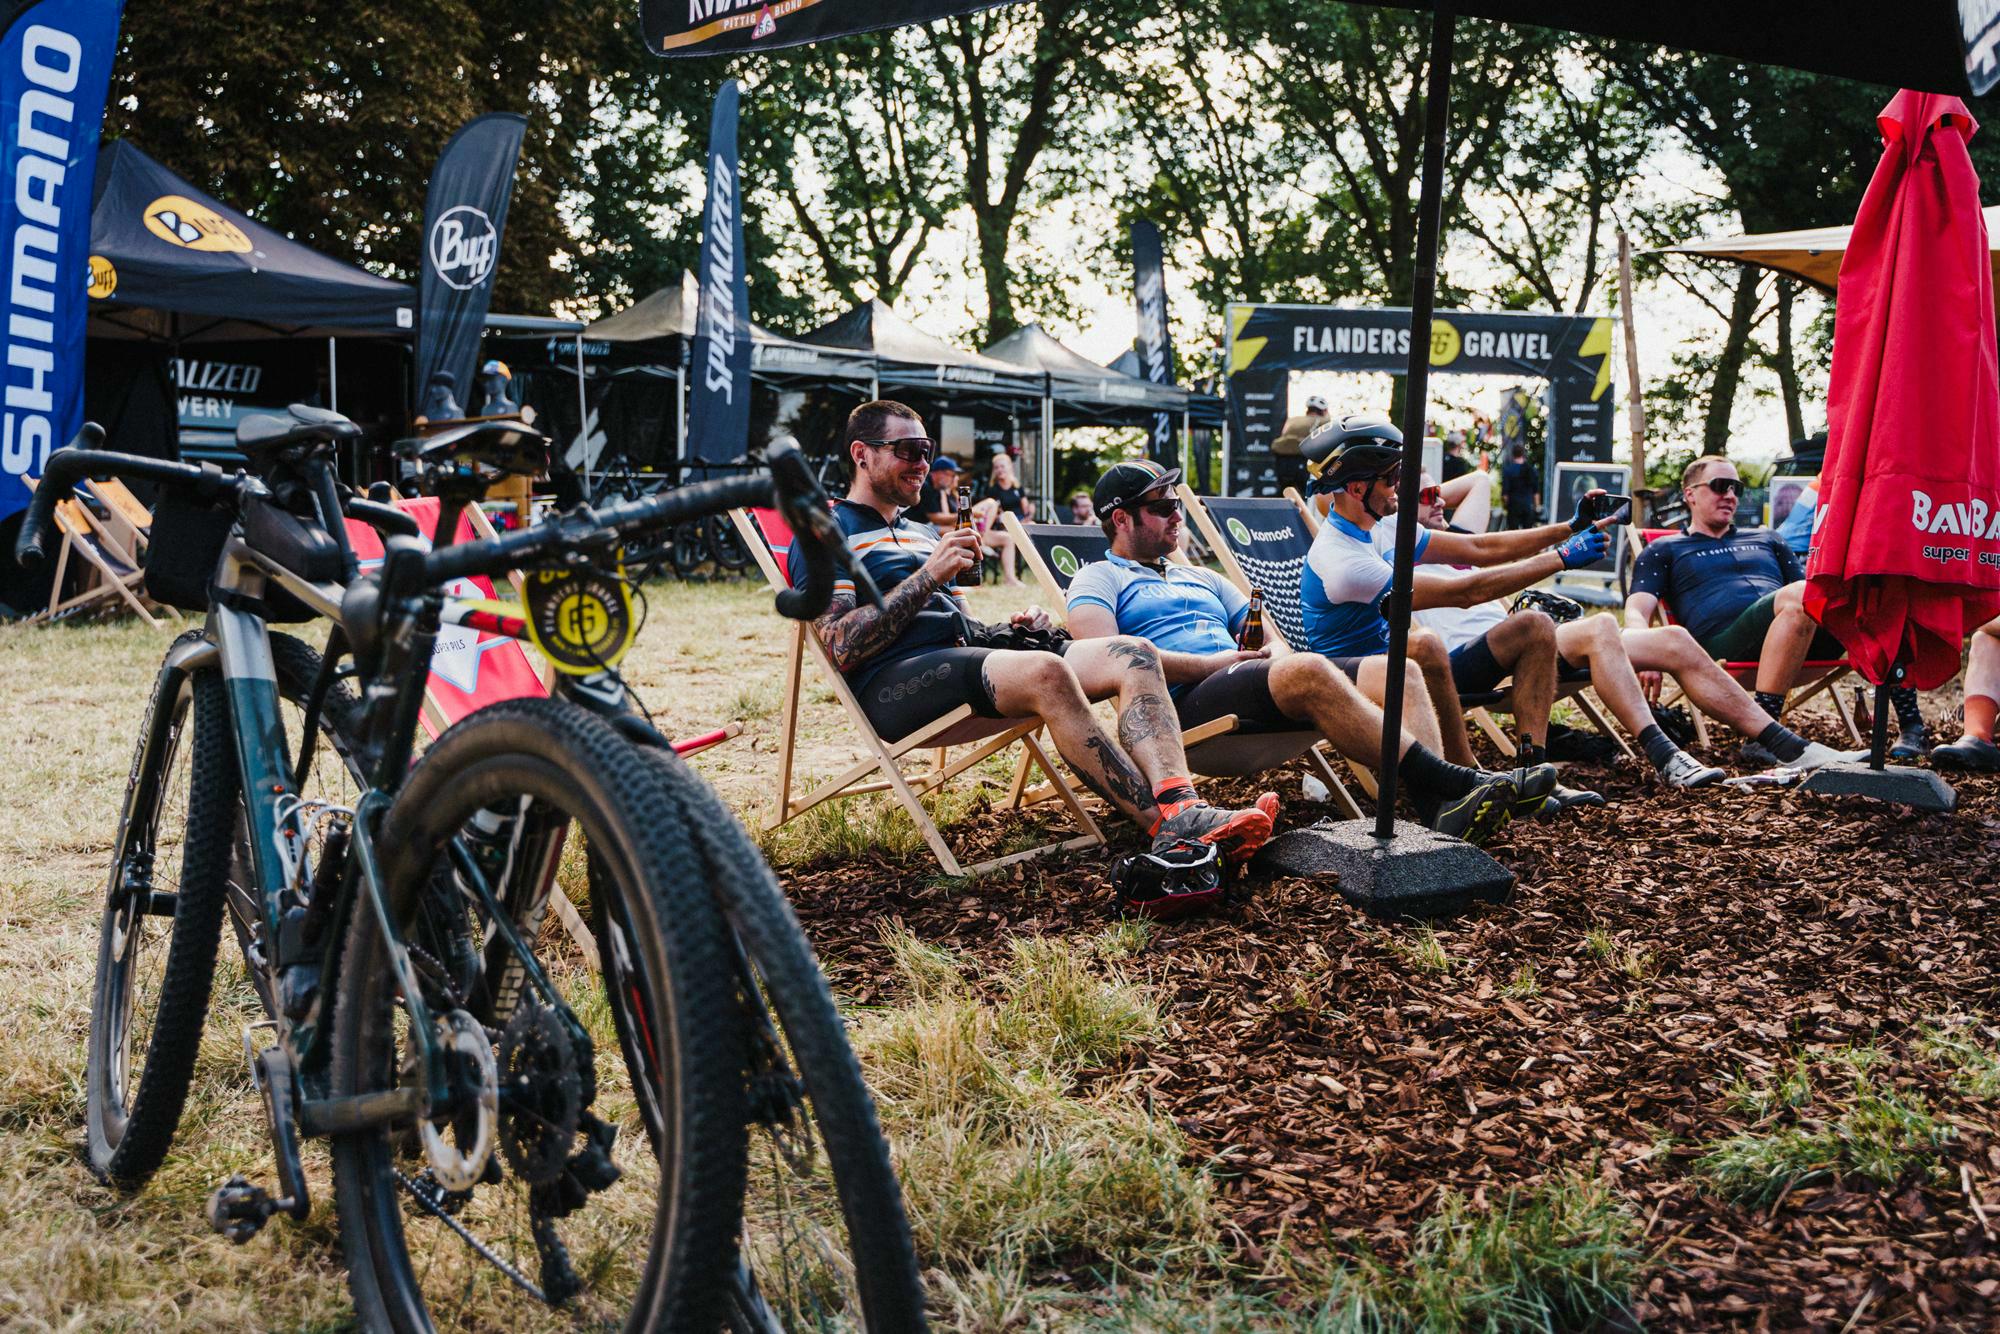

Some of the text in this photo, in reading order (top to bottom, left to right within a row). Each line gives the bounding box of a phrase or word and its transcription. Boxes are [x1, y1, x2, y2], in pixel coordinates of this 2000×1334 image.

[723, 14, 757, 30] PITTIG
[3, 24, 82, 476] SHIMANO
[706, 153, 735, 405] SPECIALIZED
[1294, 326, 1410, 355] FLANDERS
[1464, 331, 1552, 360] GRAVEL
[177, 395, 234, 418] VERY
[1250, 526, 1295, 542] komoot
